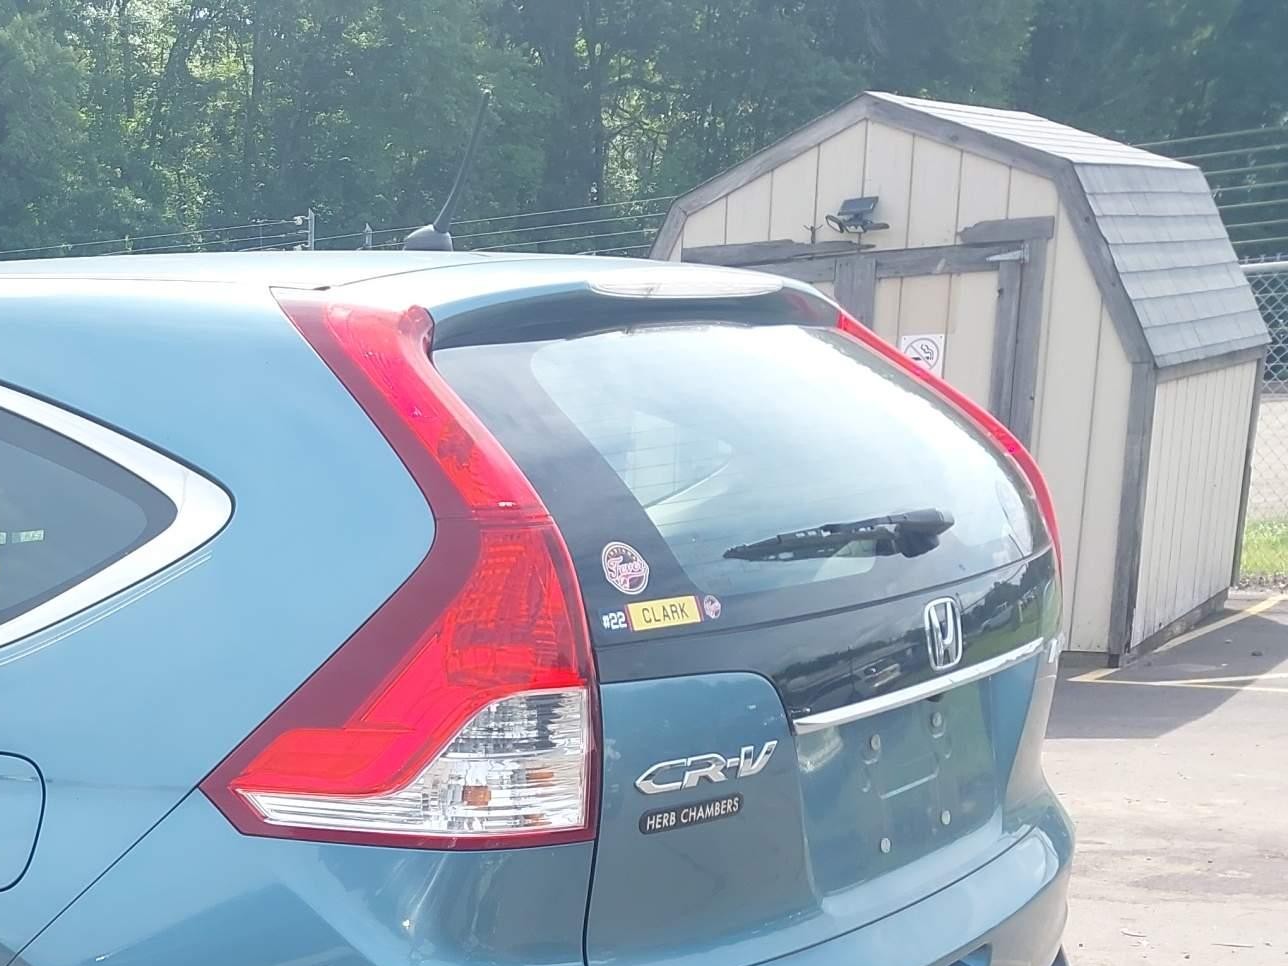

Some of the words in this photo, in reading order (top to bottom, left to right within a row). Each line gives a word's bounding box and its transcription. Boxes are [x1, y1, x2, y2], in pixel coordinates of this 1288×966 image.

[601, 611, 628, 630] #22
[641, 602, 690, 624] CLARK
[635, 739, 779, 795] CR-V
[646, 811, 676, 831] HERB
[680, 797, 740, 824] CHAMBERS
